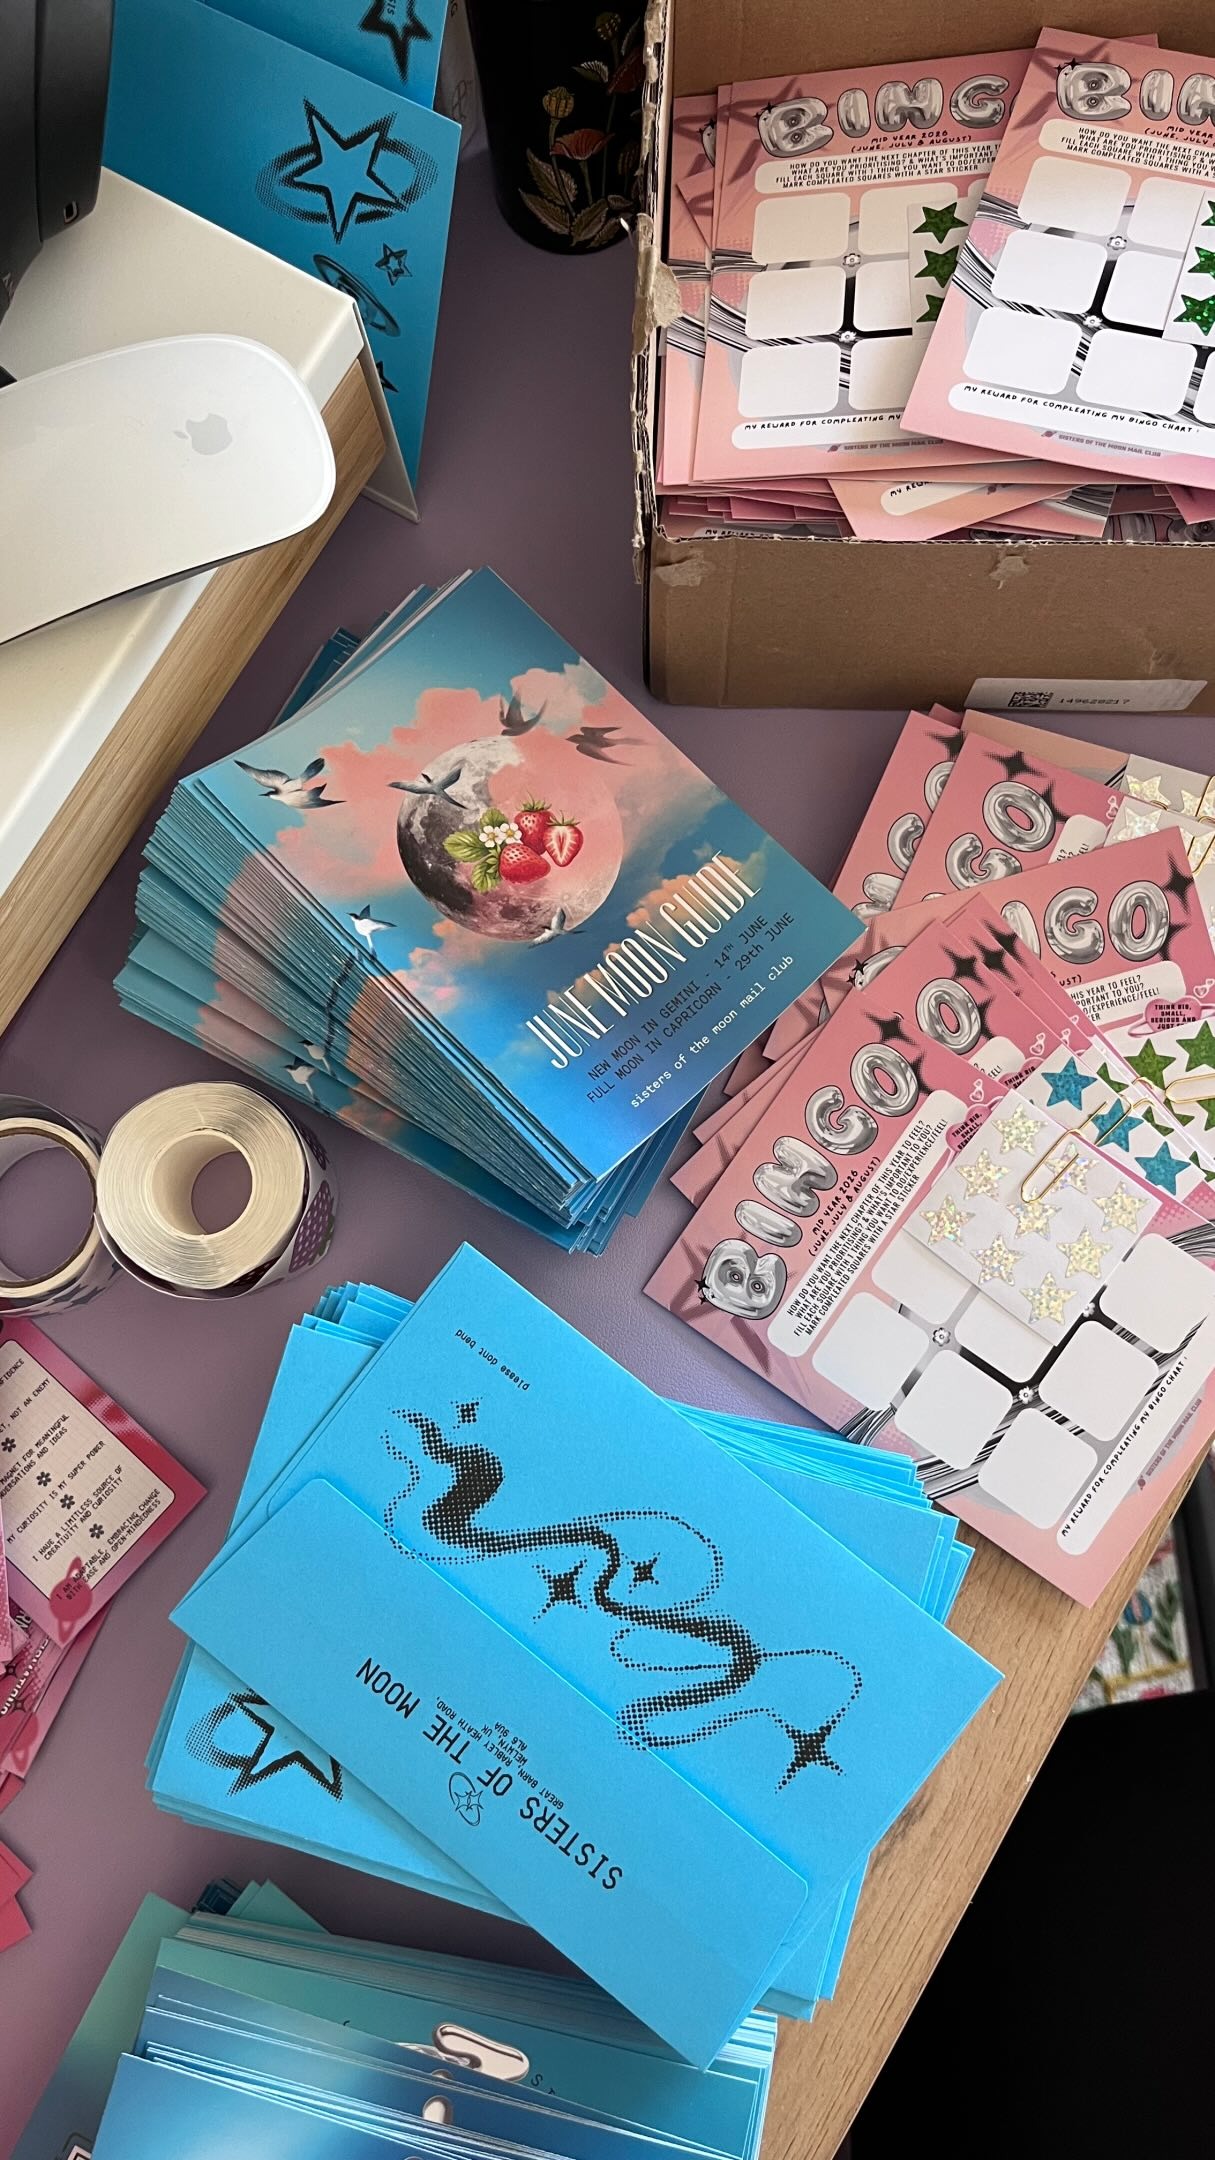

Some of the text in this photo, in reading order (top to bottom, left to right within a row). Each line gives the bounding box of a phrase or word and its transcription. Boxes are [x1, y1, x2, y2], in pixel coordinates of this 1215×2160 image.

[757, 74, 1013, 158] BING
[870, 129, 948, 144] MID YEAR 2026
[980, 388, 1017, 400] REWARD
[1020, 396, 1038, 405] FOR
[1042, 401, 1107, 417] COMPLEATING
[1128, 416, 1158, 426] BINGO
[1161, 422, 1192, 432] CHART
[525, 850, 760, 1068] JUNE MOON GUIDE
[586, 911, 794, 1102] FULL MOON IN CAPRICORN 29th JUNE
[587, 1059, 611, 1080] NEW
[610, 1033, 641, 1061] MOON
[640, 1017, 658, 1035] IN
[659, 979, 700, 1018] GEMINI
[737, 914, 768, 944] JUNE
[1085, 974, 1141, 996] YEAR TO FEEL?
[1111, 982, 1144, 997] TO YOU?
[630, 955, 793, 1107] sisters of the moon mail club
[701, 1042, 919, 1321] BINGO
[786, 1119, 924, 1316] HOW DO YOU WANT THE NEXT CHAPTER OF THIS YEAR TO FEEL?
[794, 1298, 811, 1318] WHAT
[808, 1284, 821, 1300] ARE
[817, 1269, 831, 1285] YOU
[827, 1222, 863, 1271] PRIORITISING?
[865, 1189, 887, 1215] WHAT'S
[883, 1152, 913, 1190] IMPORTANT
[909, 1142, 920, 1153] TO
[916, 1123, 932, 1142] YOU?
[807, 1156, 880, 1257] (JUNE, JULY & AUGUST)
[811, 1169, 858, 1235] MID YEAR 2026
[793, 1321, 807, 1336] FILL
[803, 1302, 819, 1322] EACH
[815, 1276, 838, 1303] SQUARE
[833, 1258, 850, 1276] WITH
[850, 1232, 869, 1253] THING
[864, 1217, 879, 1232] YOU
[875, 1197, 892, 1217] WANT
[888, 1187, 899, 1198] TO
[803, 1315, 821, 1335] MARK
[818, 1273, 850, 1316] COMPLEATED
[846, 1243, 871, 1274] SQUARES
[867, 1225, 884, 1243] WITH
[884, 1201, 900, 1220] STAR
[896, 1173, 919, 1202] STICKER
[9, 1377, 50, 1420] NOT AN ENEMY
[454, 1328, 530, 1390] please dont bend
[21, 1448, 34, 1461] FOR
[34, 1413, 70, 1448] MEANINGFUL
[36, 1426, 67, 1459] AND IDEAS
[1061, 1360, 1184, 1536] MY REWARD FOR COMPLEATING MY BINGO CHART
[6, 1440, 105, 1544] MY CURIOSITY IS MY SUPER POWER
[37, 1538, 54, 1555] HAVE
[60, 1497, 93, 1531] LIMITLESS
[92, 1474, 114, 1498] SOURCE
[113, 1464, 122, 1474] OF
[43, 1476, 122, 1560] CREATIVITY AND CURIOSITY
[355, 1657, 622, 1889] SISTERS OF THE MOON
[436, 1696, 564, 1810] GREAT BARN, RABLEY HEATH ROAD,
[480, 1723, 528, 1766] WELWYN, UK
[494, 1721, 527, 1751] AL6 9UA
